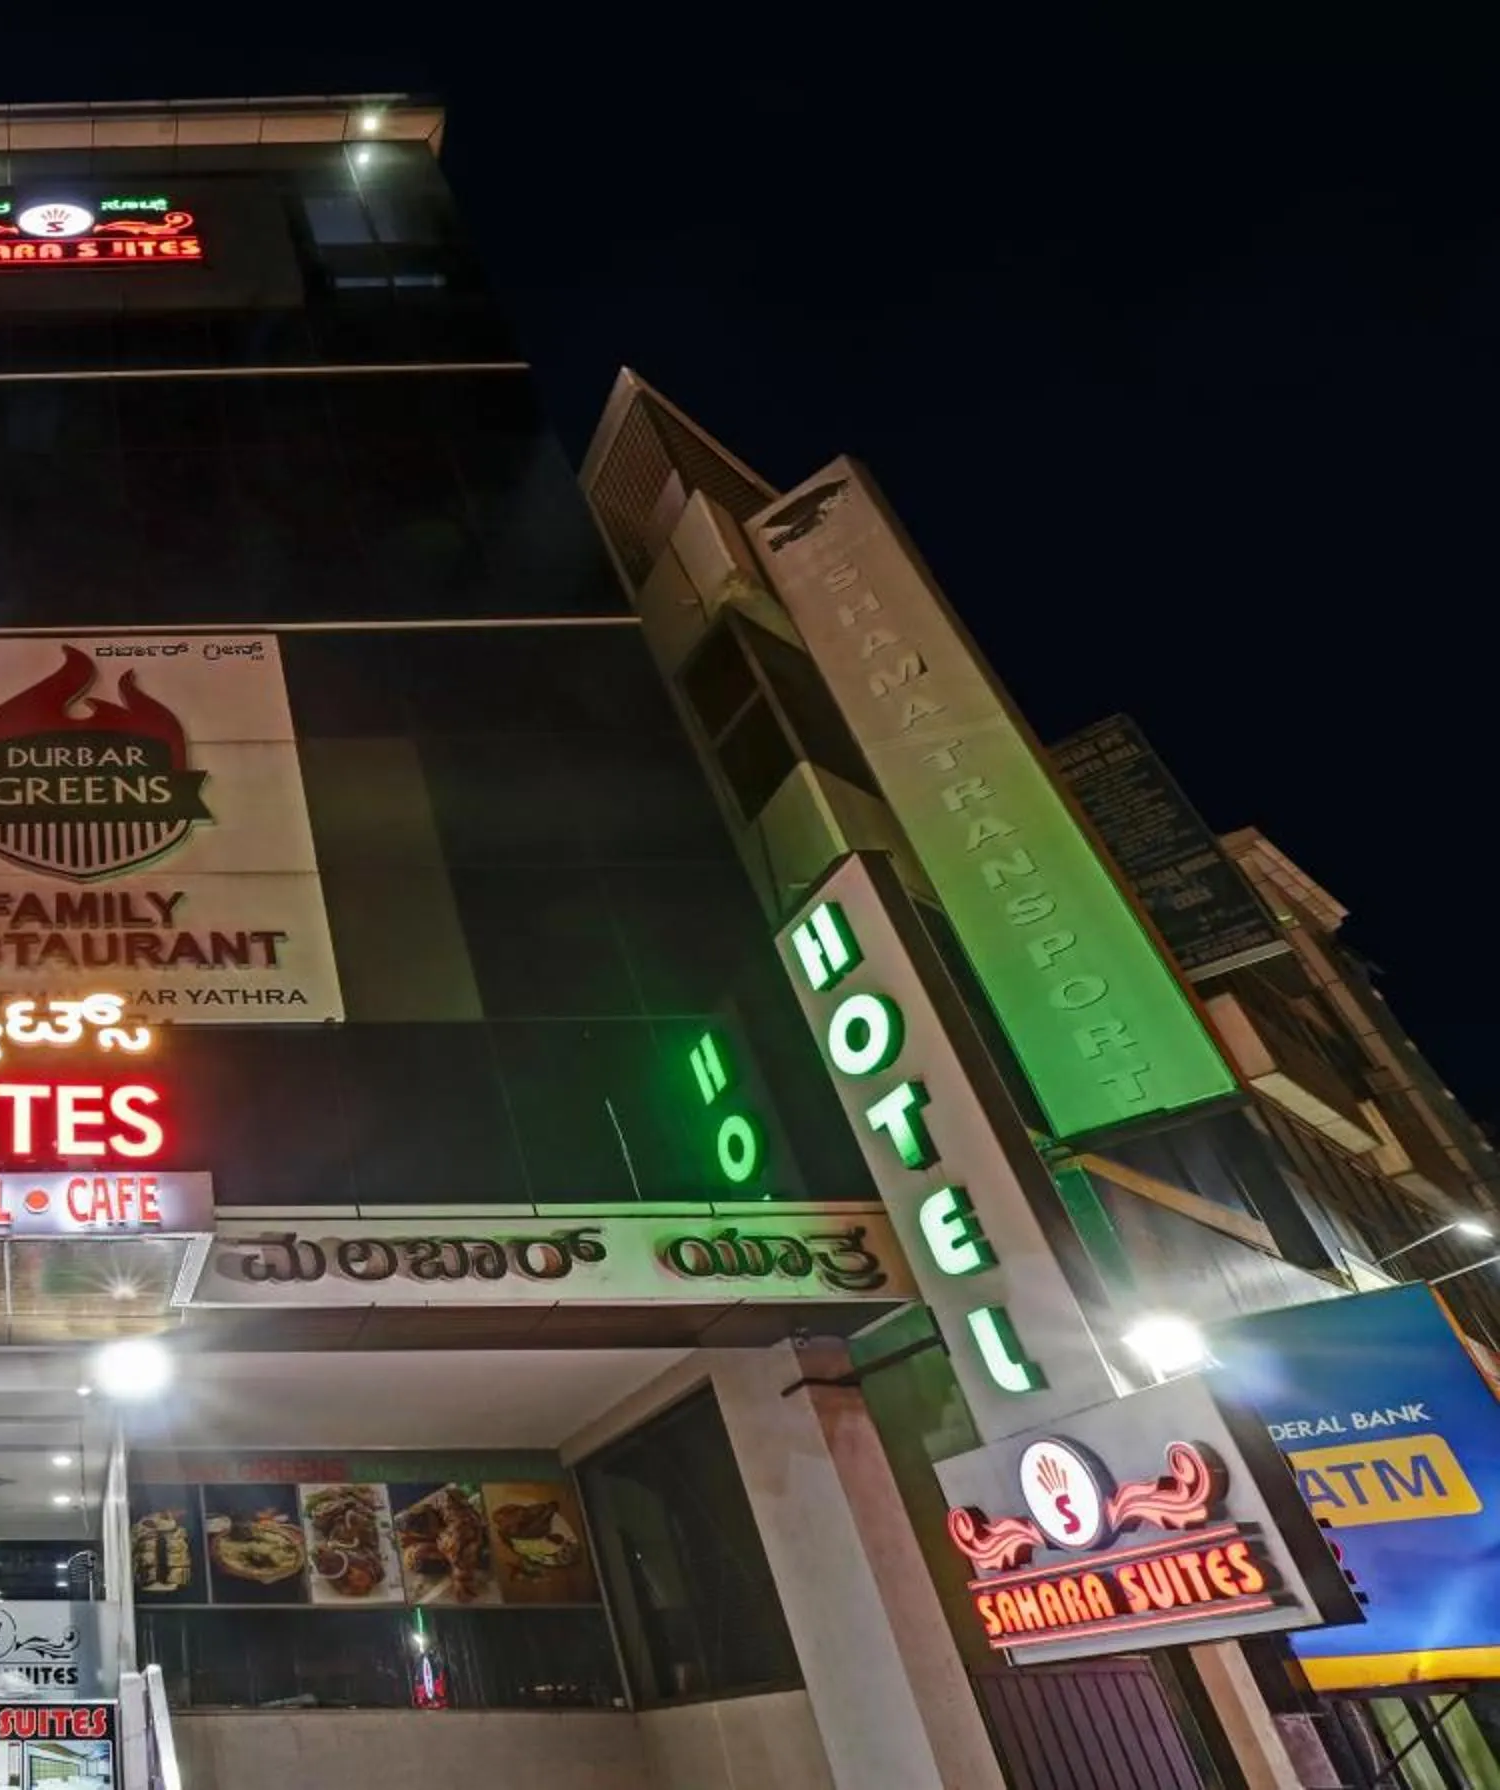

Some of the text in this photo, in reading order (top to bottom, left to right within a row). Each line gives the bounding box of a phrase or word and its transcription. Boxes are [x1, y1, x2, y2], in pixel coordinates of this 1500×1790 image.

[7, 746, 148, 768] DURBAR
[922, 738, 1153, 1106] TRANSPORT
[184, 988, 308, 1006] YATHRA
[791, 902, 1046, 1394] HOTEL
[66, 1177, 162, 1224] CAFE
[1268, 1403, 1433, 1441] DERAL BANK
[1296, 1454, 1448, 1508] ATM
[1055, 1496, 1081, 1535] S
[977, 1541, 1264, 1635] SAHARA SUITES
[3, 1665, 80, 1685] UITES
